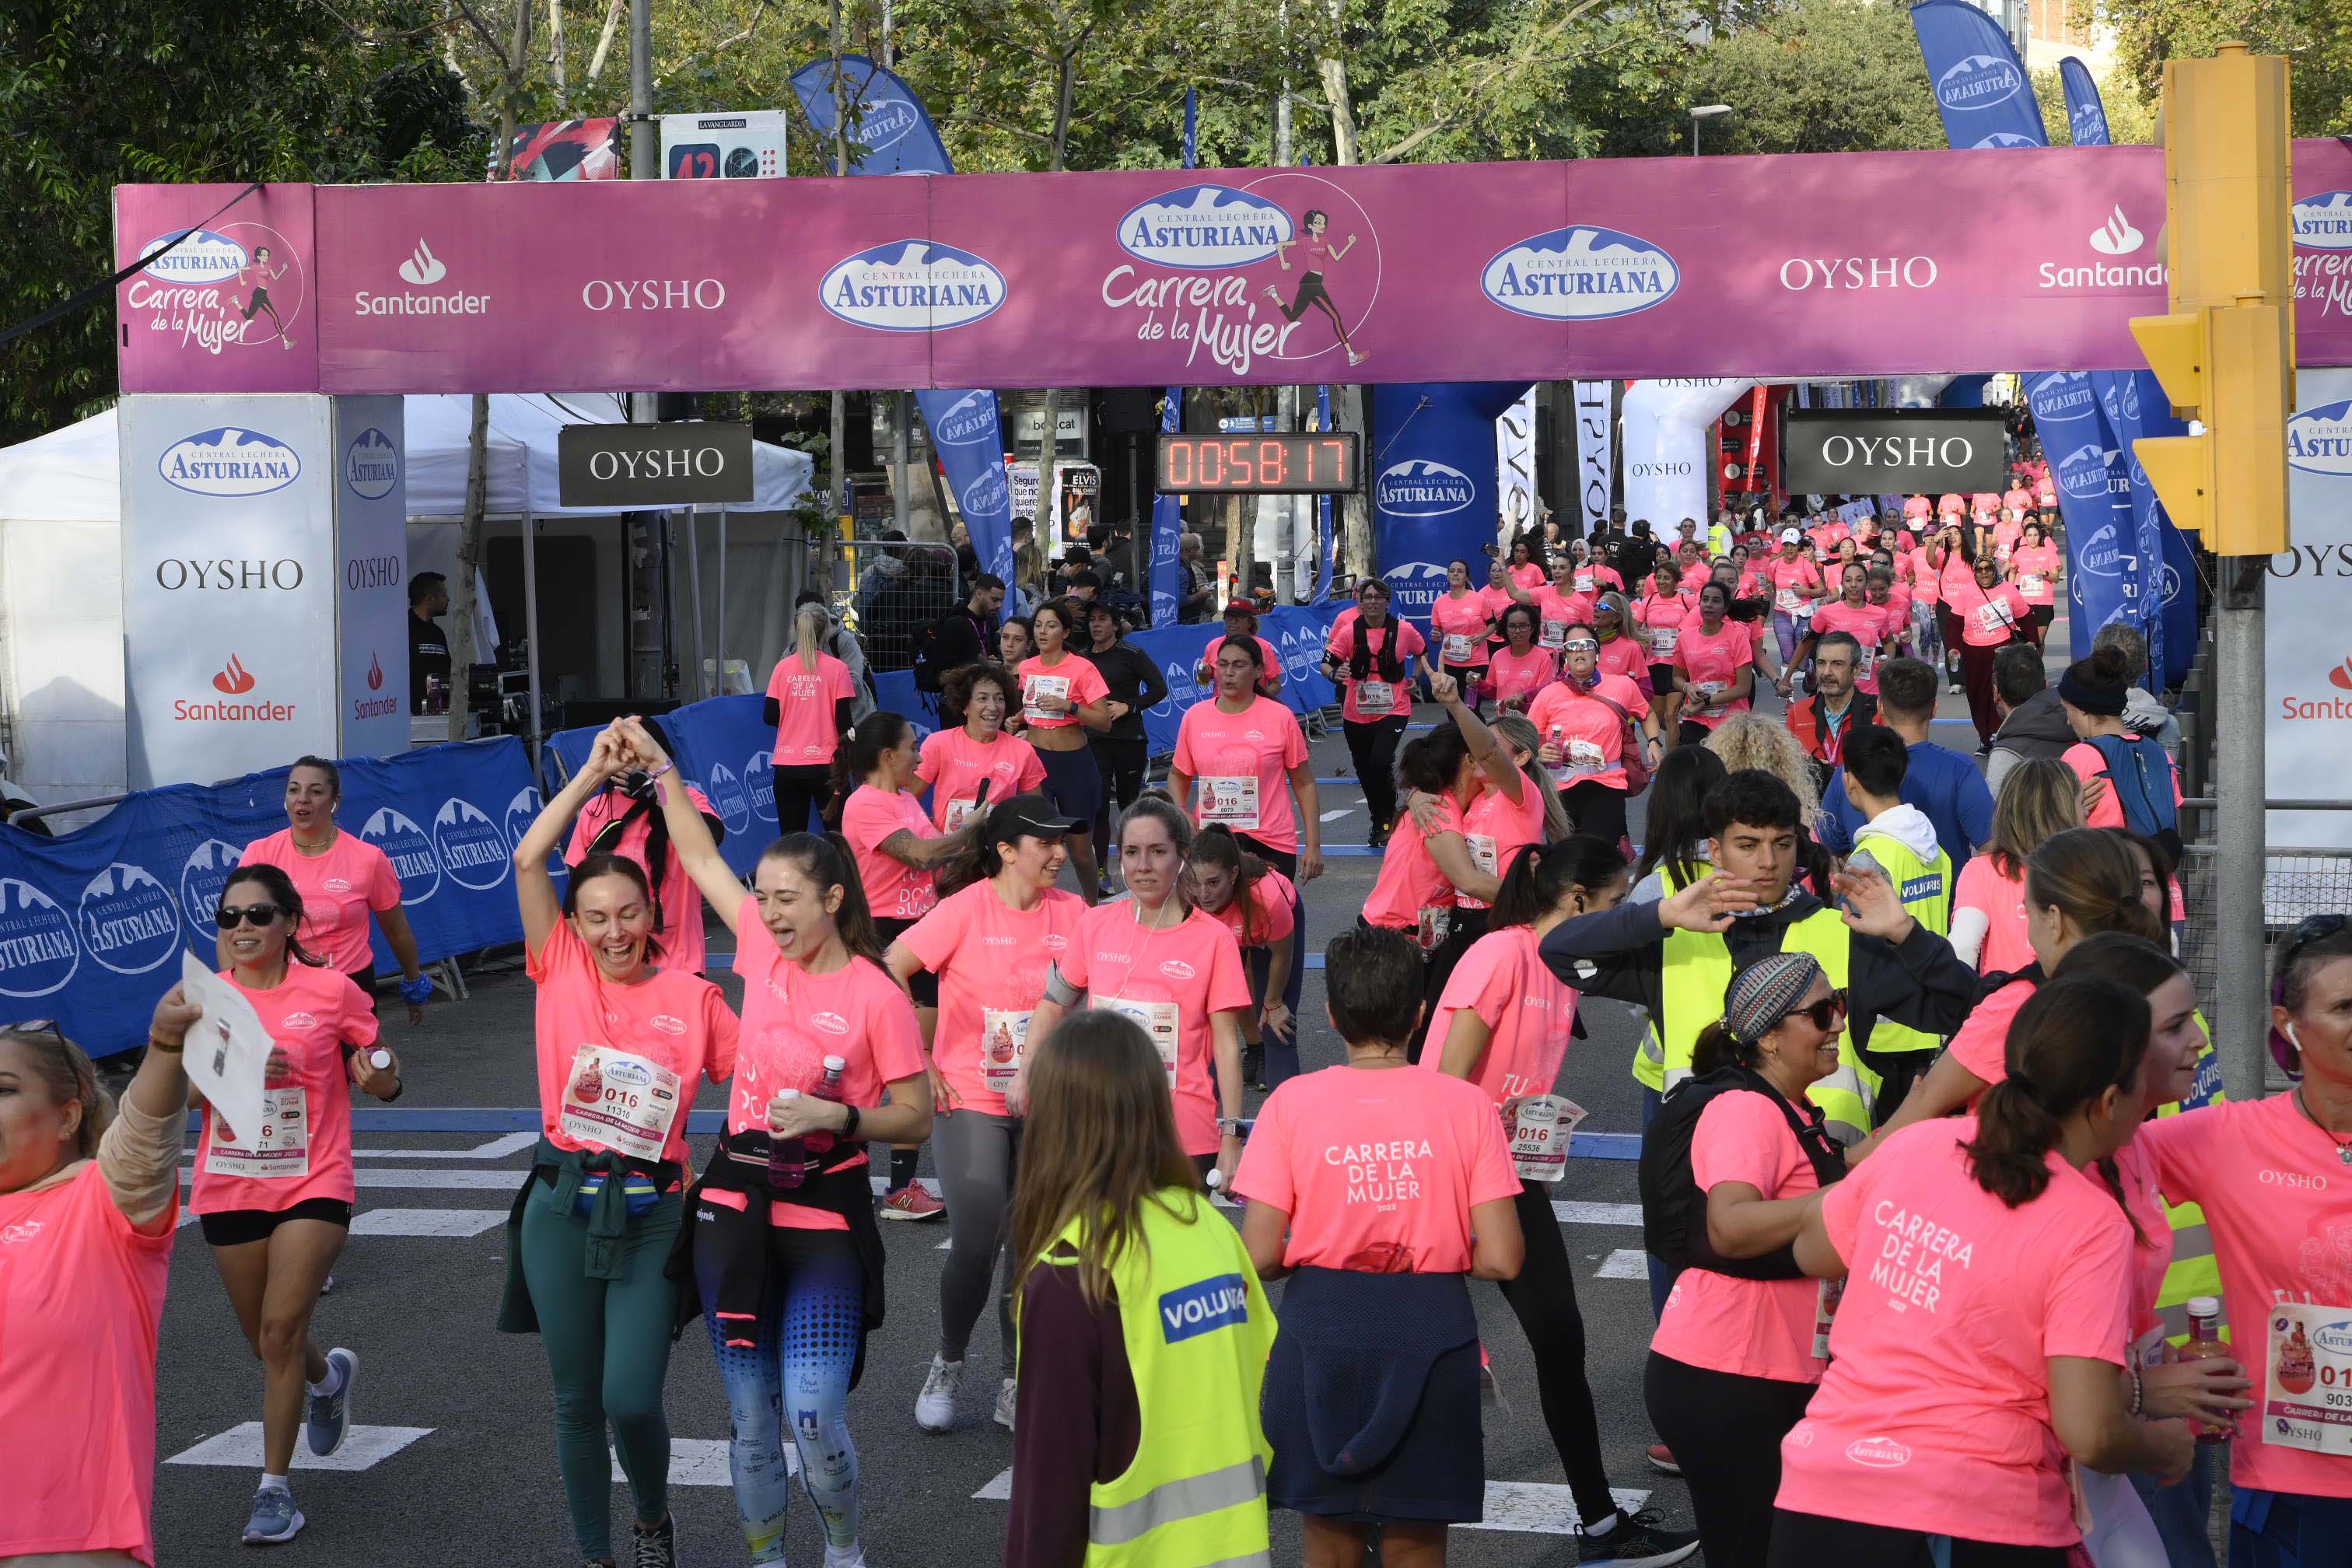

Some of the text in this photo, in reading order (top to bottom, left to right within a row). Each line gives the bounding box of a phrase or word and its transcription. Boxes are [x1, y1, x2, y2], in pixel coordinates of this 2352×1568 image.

[707, 119, 746, 128] VANGUARDIA
[1157, 212, 1275, 223] CENTRAL LECHERA
[1130, 216, 1280, 249] ASTURIANA
[145, 248, 240, 270] ASTURIANA
[1527, 256, 1657, 268] CENTRAL LECHERA
[863, 269, 986, 282] CENTRAL LECHERA
[1496, 262, 1664, 297] ASTURIANA
[1779, 256, 1938, 291] OYSHO
[128, 280, 220, 310] Carrera
[583, 278, 726, 311] OYSHO
[834, 274, 992, 308] ASTURIANA
[1101, 264, 1247, 309] Carrera
[2311, 277, 2325, 299] la
[355, 290, 491, 316] Santander
[151, 306, 254, 355] de la Mujer
[1138, 302, 1302, 376] de la Mujer
[1658, 377, 1722, 389] OYSHO
[590, 447, 725, 481] OYSHO
[1168, 440, 1345, 485] 00:58:17
[1822, 436, 1973, 468] OYSHO
[170, 453, 292, 479] ASTURIANA
[349, 453, 395, 482] ASTURIANA
[1632, 461, 1691, 478] OYSHO
[1015, 487, 1027, 497] que
[1072, 475, 1097, 485] ELVIS
[1379, 482, 1468, 505] ASTURIANA
[156, 558, 303, 590] OYSHO
[347, 555, 400, 591] OYSHO
[786, 675, 821, 684] CARRERA
[173, 699, 296, 722] Santander
[354, 695, 397, 721] Santander
[1217, 797, 1237, 806] 016
[440, 835, 506, 870] ASTURIANA
[1096, 951, 1131, 964] OYSHO
[607, 1067, 647, 1084] ASTURIANA
[1501, 1073, 1530, 1097] TU
[604, 1088, 639, 1108] 016
[576, 1109, 604, 1122] CARRERA
[621, 1122, 641, 1135] MUJER
[605, 1104, 631, 1120] 11310
[569, 1120, 602, 1136] OYSHO
[1518, 1128, 1549, 1142] 016
[621, 1138, 654, 1152] Santander
[1325, 1139, 1433, 1166] CARRERA
[1517, 1143, 1542, 1153] 25536
[215, 1160, 245, 1171] OYSHO
[1349, 1160, 1416, 1184] DE LA
[2259, 1168, 2327, 1191] OYSHO
[1346, 1180, 1421, 1205] MUJER
[1874, 1200, 1973, 1271] CARRERA
[1881, 1234, 1943, 1286] DE LA
[1869, 1262, 1941, 1314] MUJER
[2283, 1405, 2352, 1423] CARRERA DE LA
[1853, 1444, 1905, 1462] ASTURIANA
